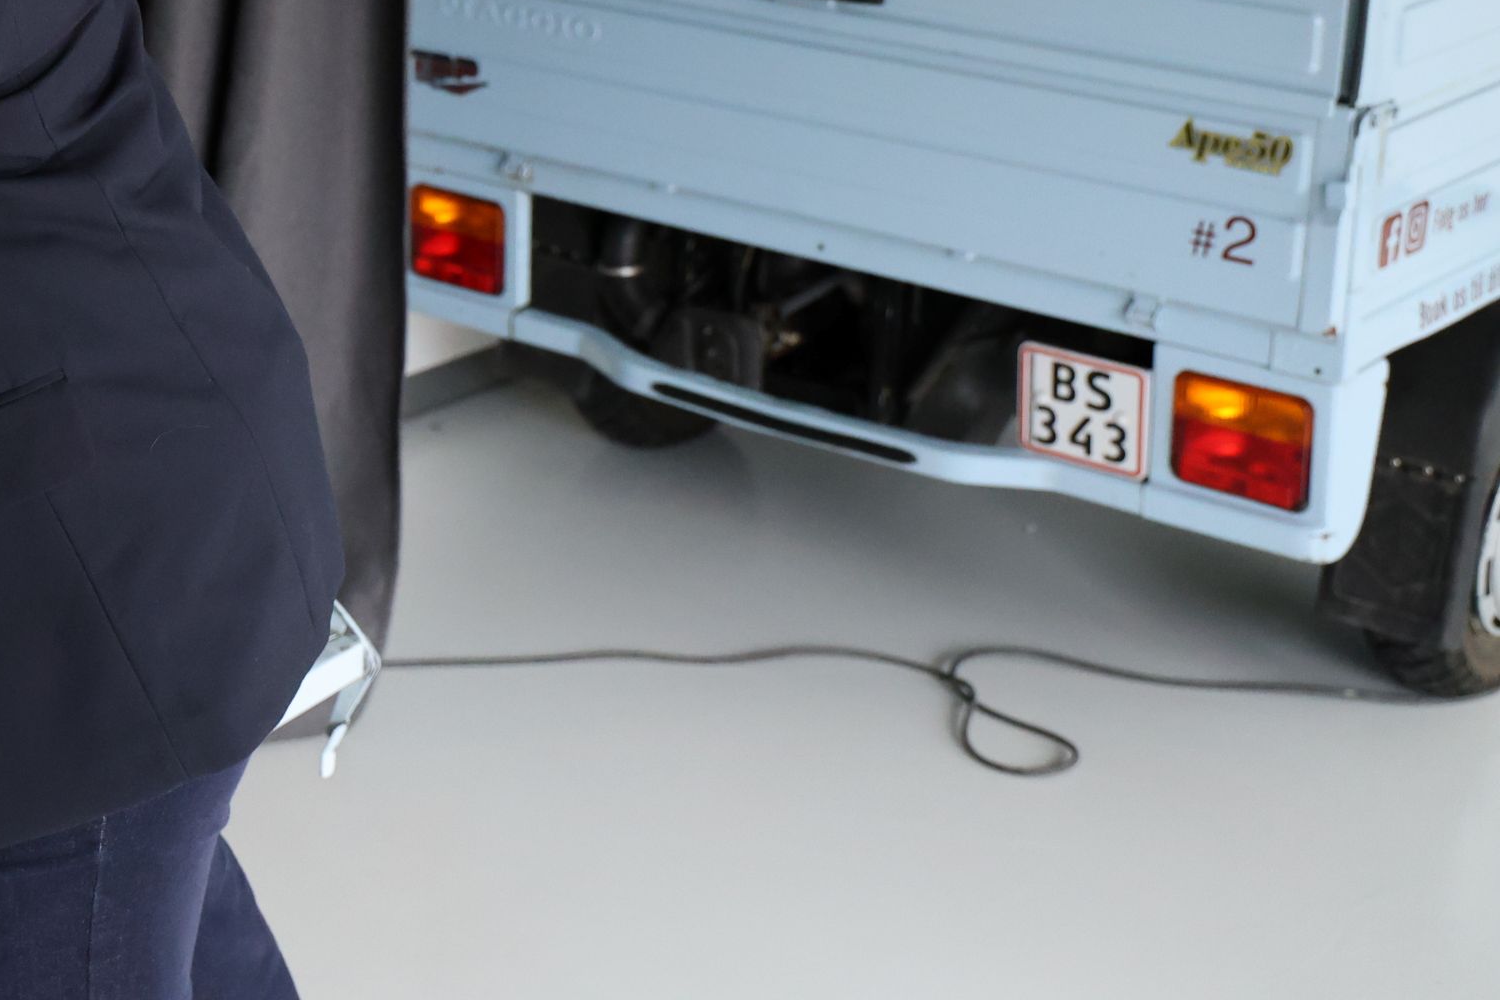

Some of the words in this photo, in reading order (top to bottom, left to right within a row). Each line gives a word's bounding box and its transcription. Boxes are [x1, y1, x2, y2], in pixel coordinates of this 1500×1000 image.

[1190, 216, 1256, 266] #2
[1053, 361, 1111, 412] BS
[1033, 405, 1127, 463] 343
